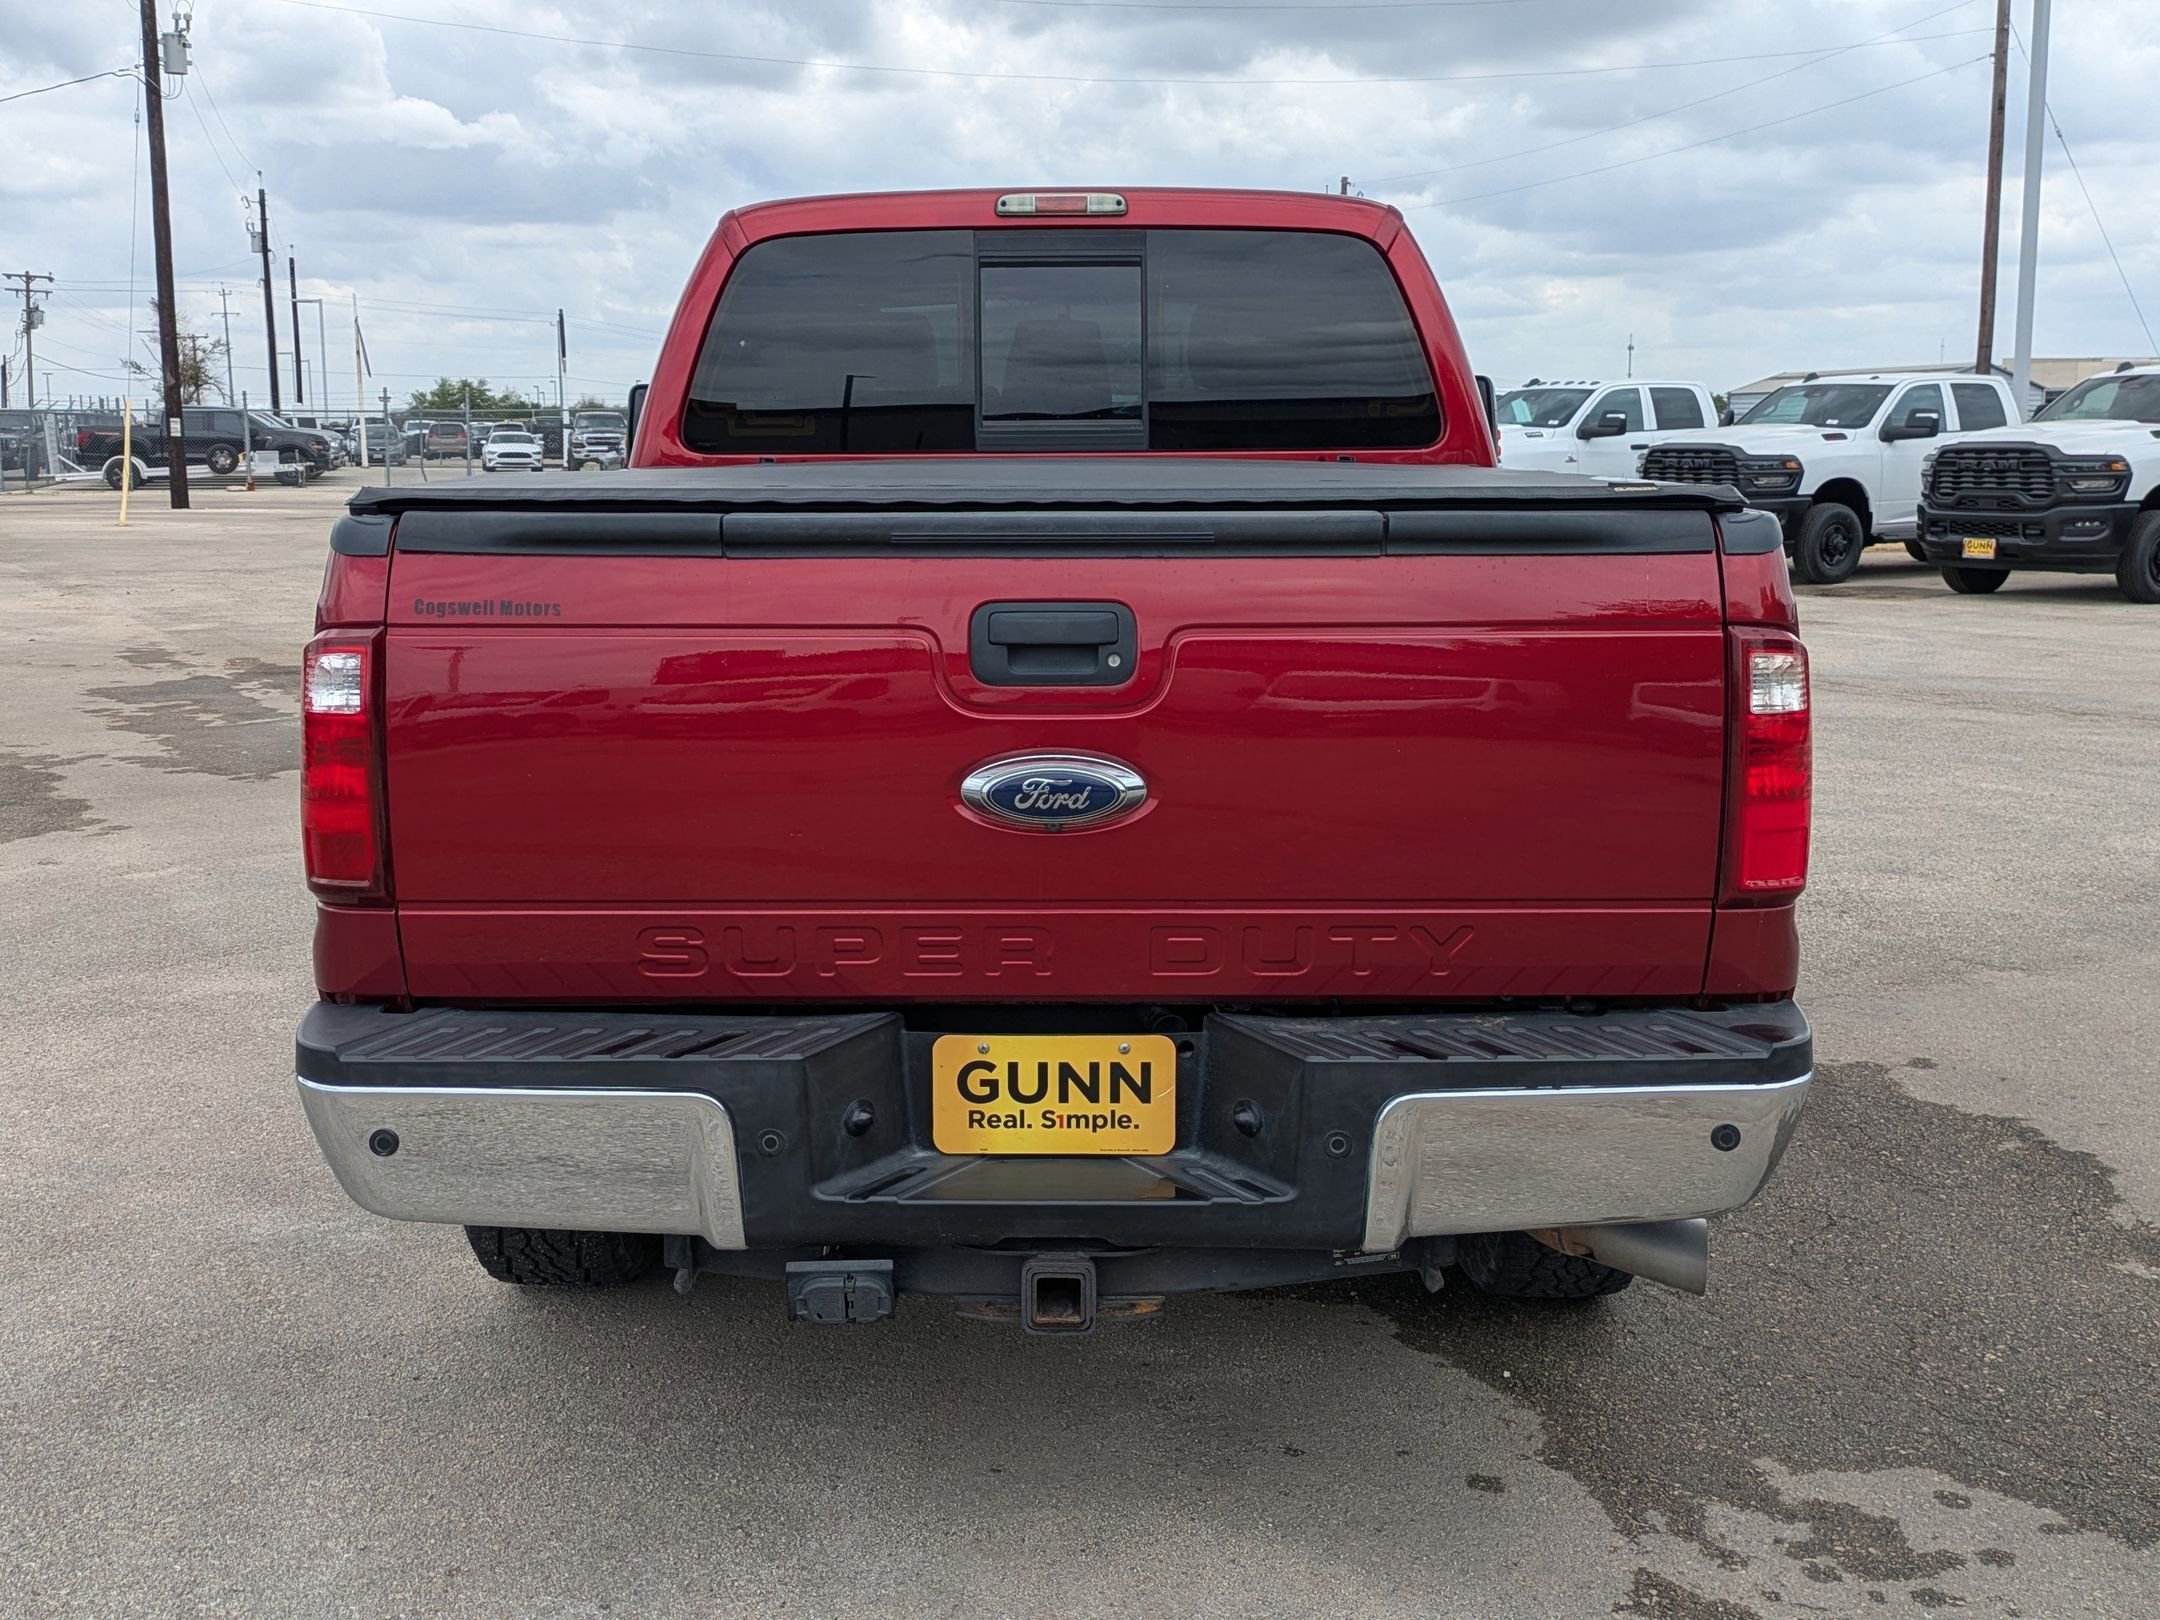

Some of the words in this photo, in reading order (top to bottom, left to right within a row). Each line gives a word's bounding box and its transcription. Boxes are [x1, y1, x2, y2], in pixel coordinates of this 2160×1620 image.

[1662, 458, 1712, 469] RAM
[1960, 459, 2019, 471] RAM
[1966, 540, 1993, 550] GUNN
[414, 599, 494, 618] Cogswell
[500, 600, 561, 616] Motors
[1014, 777, 1092, 810] Ford
[636, 925, 1053, 977] SUPER
[1150, 925, 1475, 976] DUTY
[956, 1060, 1152, 1105] GUNN
[968, 1110, 1033, 1129] Real.
